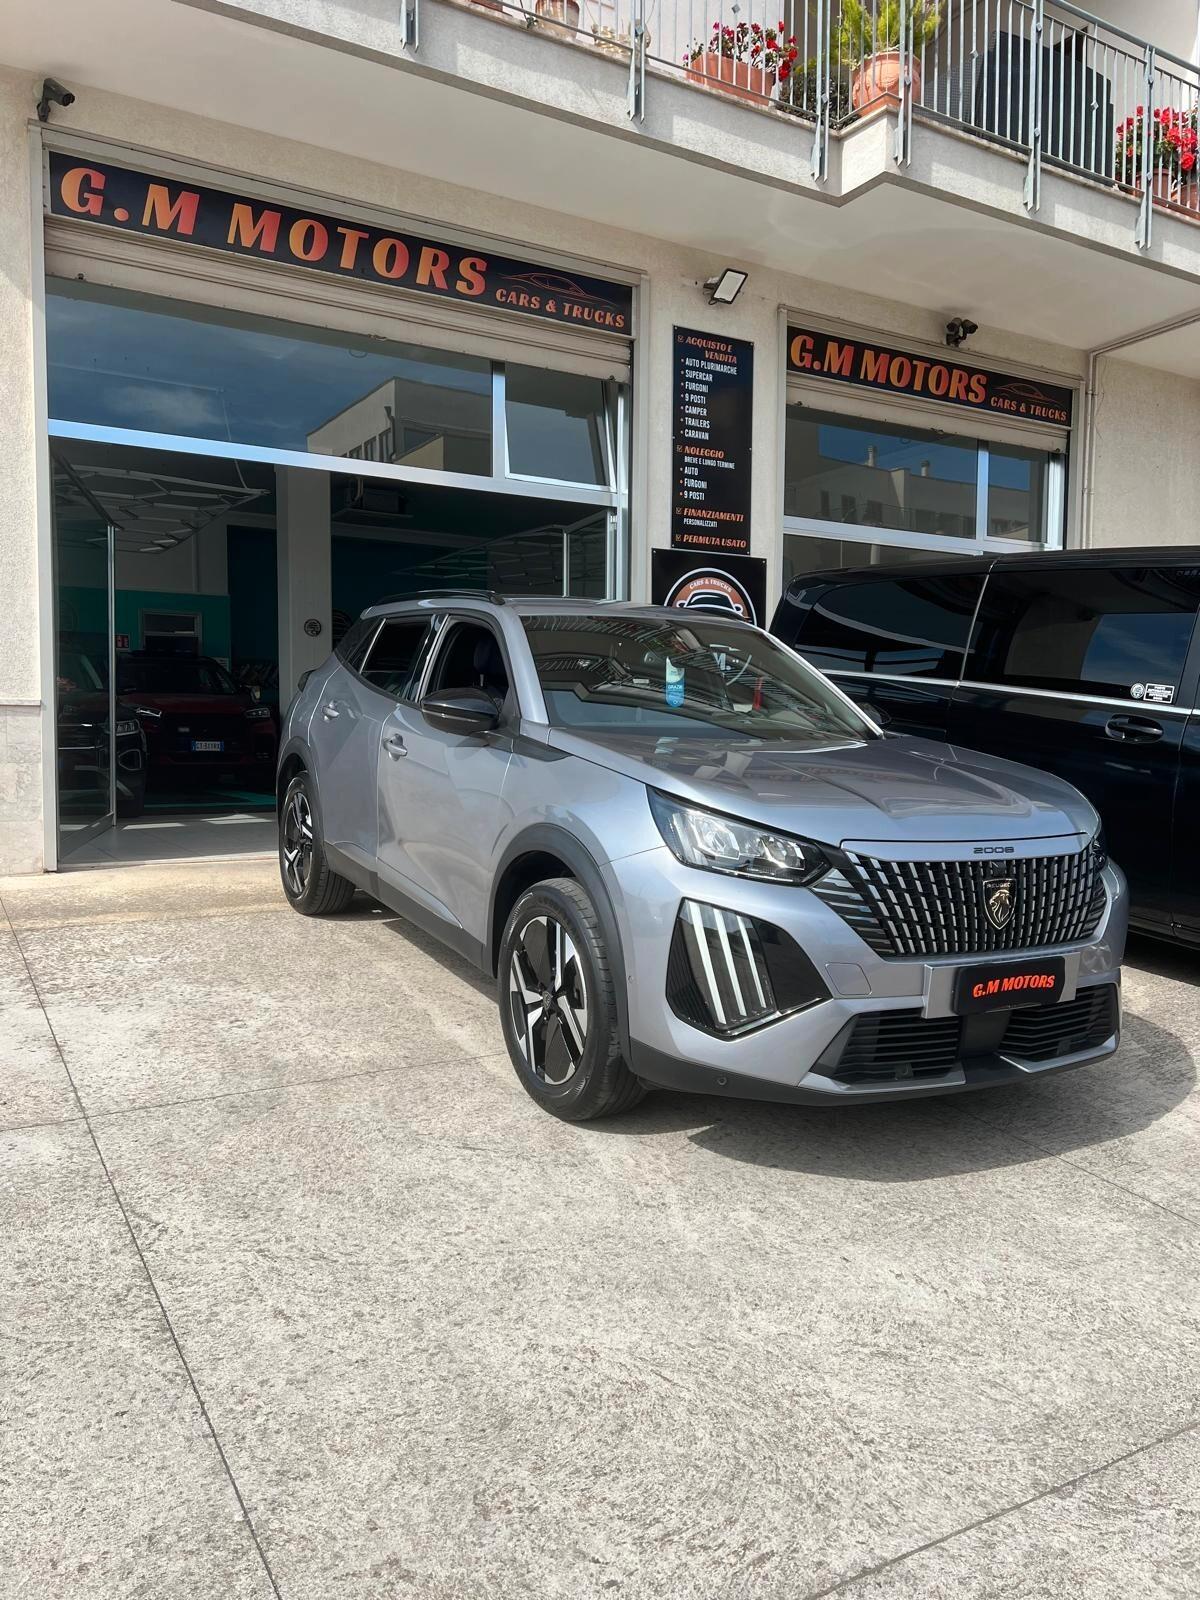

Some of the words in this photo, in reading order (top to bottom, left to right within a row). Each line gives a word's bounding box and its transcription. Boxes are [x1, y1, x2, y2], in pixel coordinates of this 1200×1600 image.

[61, 167, 200, 235] G.M
[227, 203, 488, 296] MOTORS
[496, 288, 541, 309] CARS
[546, 298, 557, 313] &
[562, 302, 625, 328] TRUCKS
[686, 336, 726, 351] ACQUISTO
[728, 344, 732, 352] E
[705, 350, 737, 364] VENDITA
[686, 358, 699, 367] AUTO
[700, 361, 737, 375] PLURIMARCHE
[791, 335, 854, 376] G.M
[860, 350, 987, 403] MOTORS
[685, 370, 712, 382] SUPERCAR
[685, 382, 708, 392] FURGONI
[690, 394, 706, 404] POSTI
[685, 405, 707, 416] CAMPER
[991, 396, 1017, 410] CARS
[1020, 403, 1026, 413] &
[1030, 405, 1067, 420] TRUCKS
[685, 417, 710, 428] TRAILERS
[685, 429, 709, 440] CARAVAN
[684, 446, 724, 458] NOLEGGIO
[684, 456, 698, 464] BREVE
[702, 458, 716, 467] LUNGO
[717, 461, 735, 469] TERMINE
[684, 467, 698, 475] AUTO
[684, 478, 707, 488] FURGONI
[689, 491, 704, 500] POSTI
[684, 508, 744, 522] FINANZIAMENTI
[684, 518, 717, 527] PERSONALIZZATI
[683, 534, 720, 545] PERMUTA
[722, 538, 746, 548] USATO
[690, 580, 704, 589] CARS
[710, 579, 732, 592] TRUCKS
[972, 979, 1000, 998] G.M
[1001, 975, 1055, 991] MOTORS
